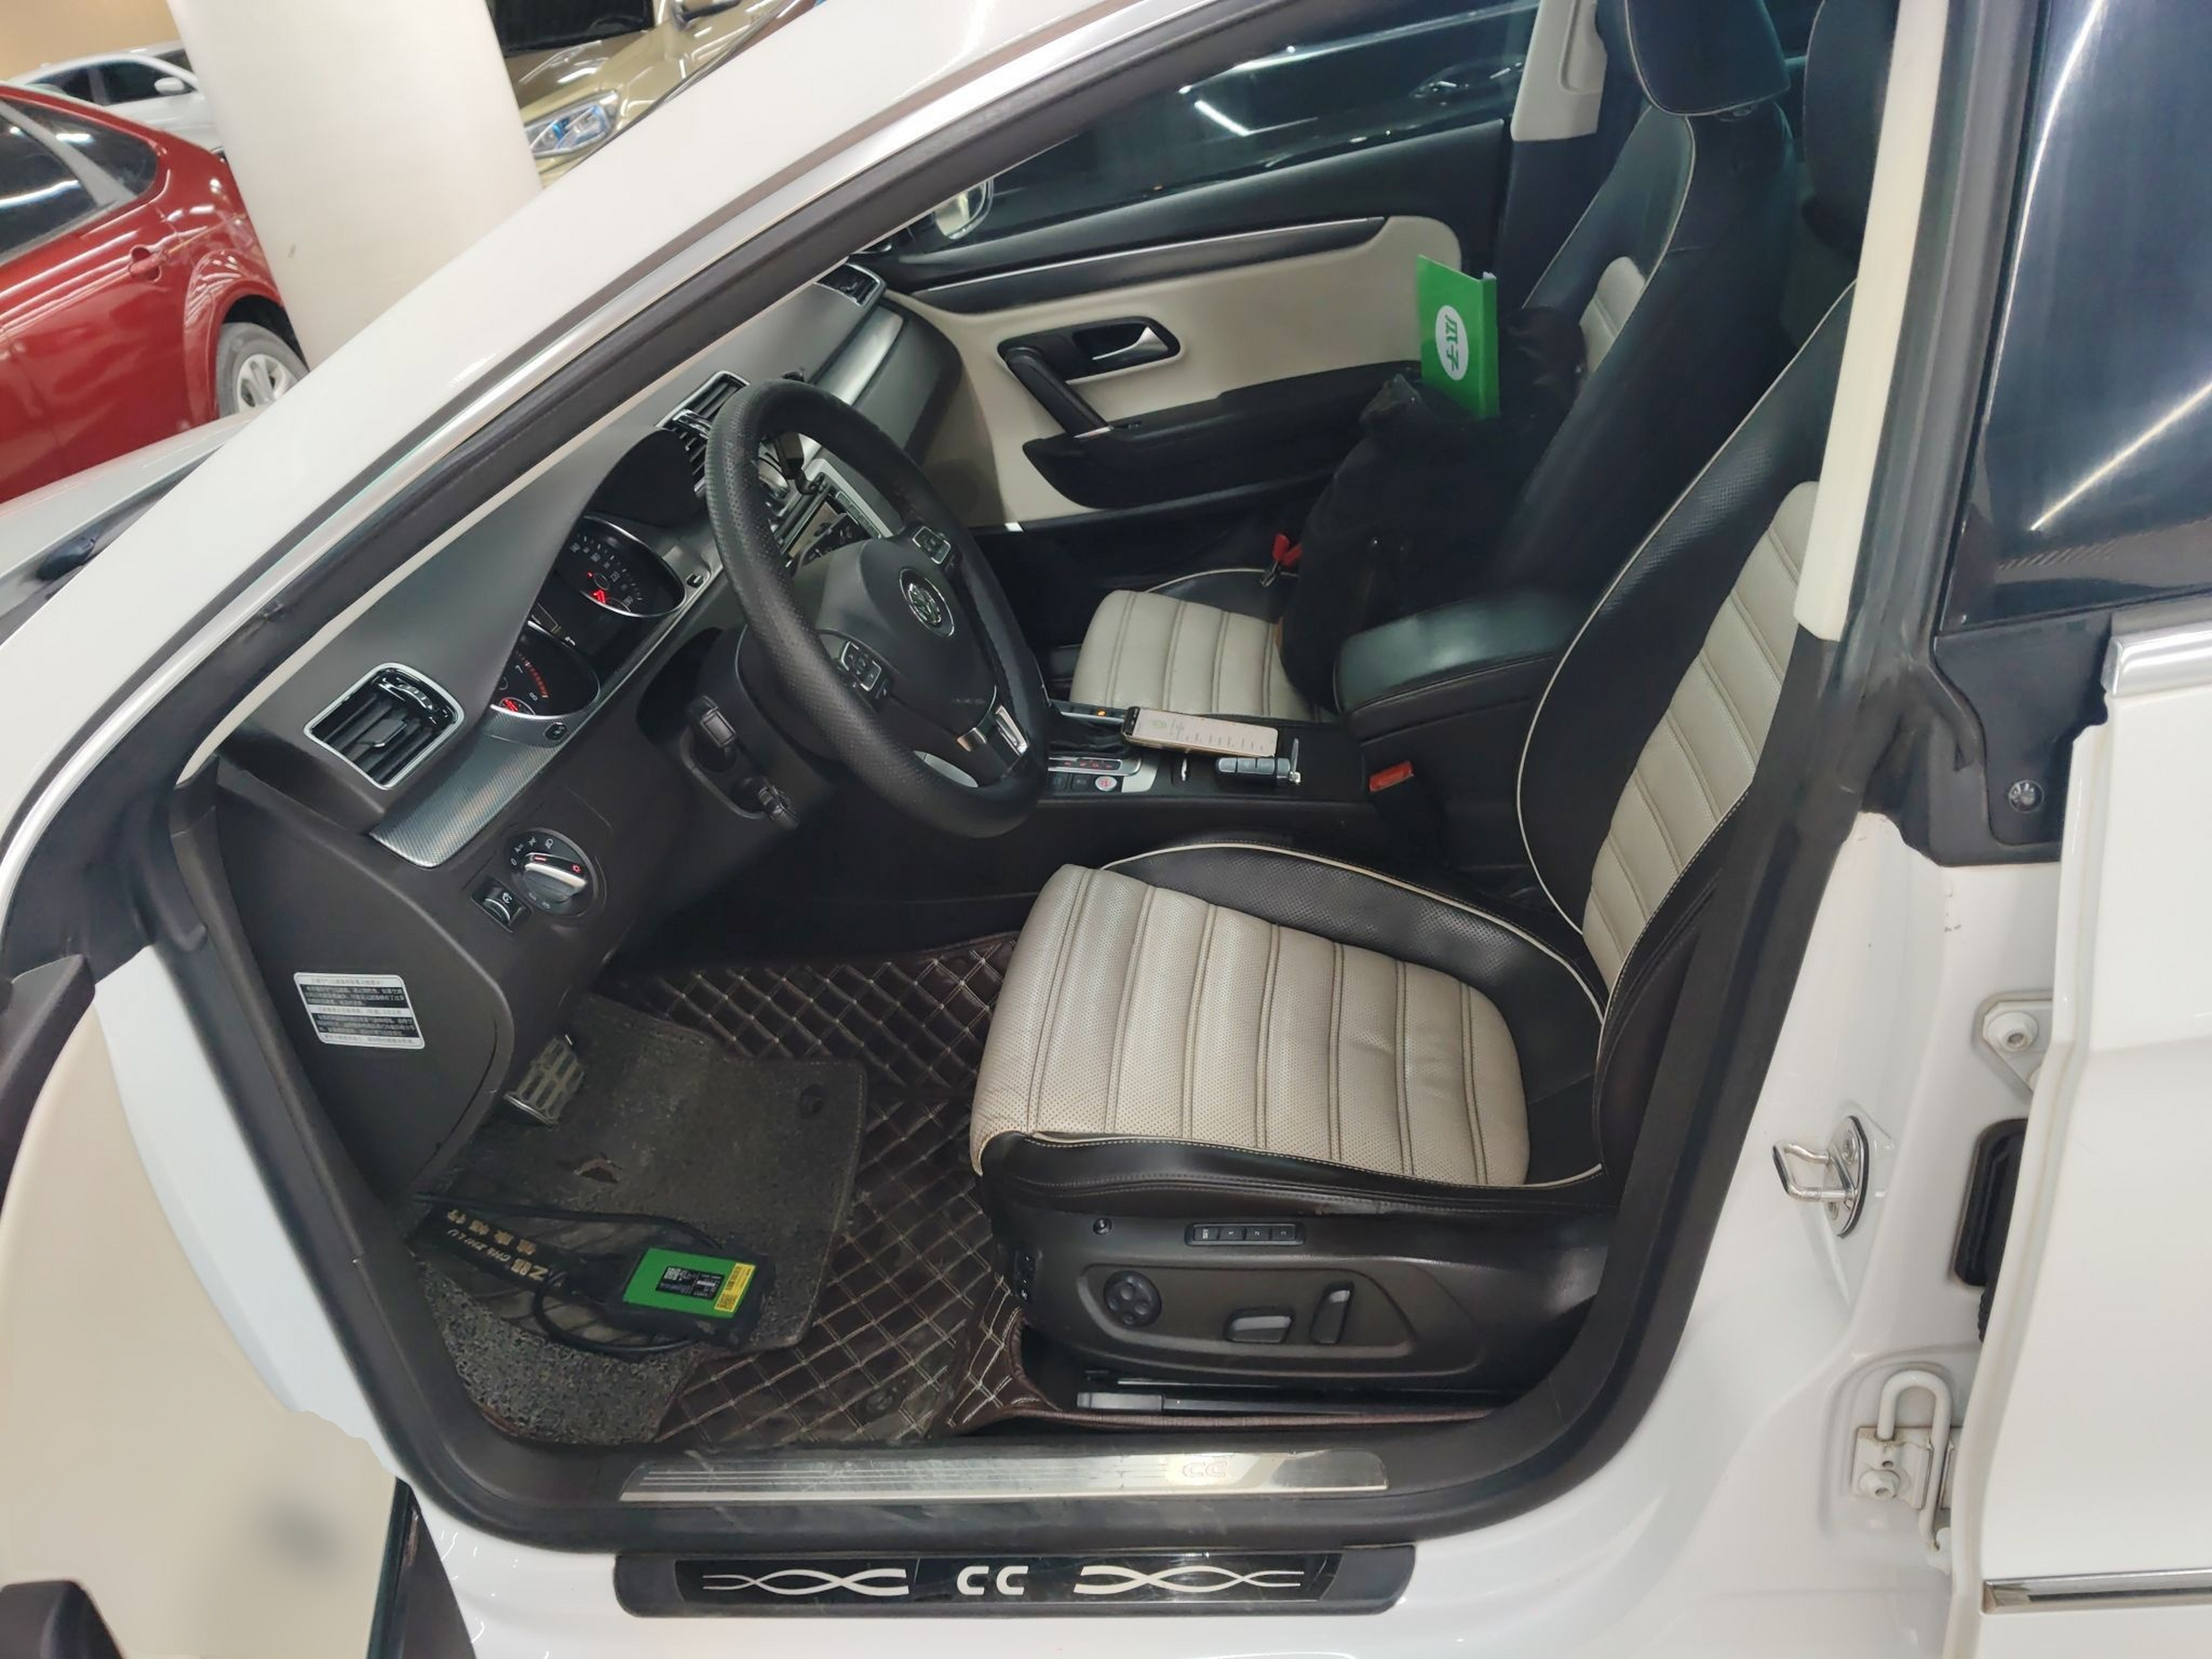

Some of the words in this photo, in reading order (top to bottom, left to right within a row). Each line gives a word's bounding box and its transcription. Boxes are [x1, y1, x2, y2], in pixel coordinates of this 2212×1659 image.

[1444, 314, 1459, 372] 瓜子
[529, 692, 538, 701] 8
[957, 1566, 1029, 1595] CC
